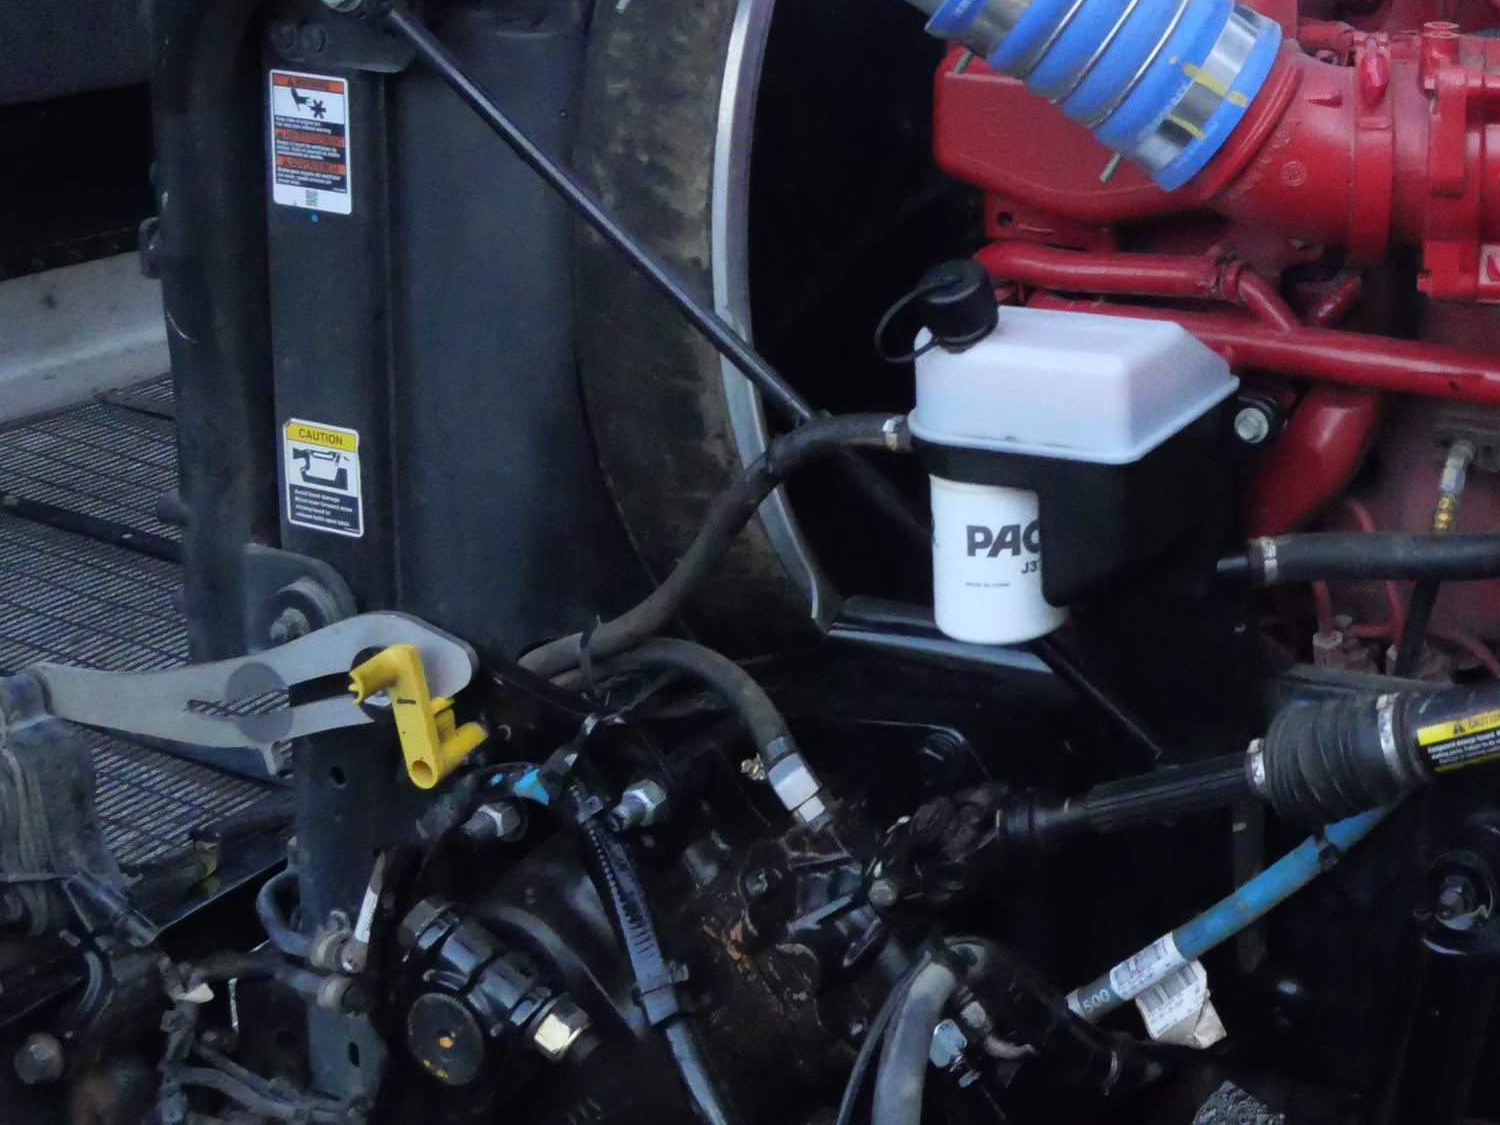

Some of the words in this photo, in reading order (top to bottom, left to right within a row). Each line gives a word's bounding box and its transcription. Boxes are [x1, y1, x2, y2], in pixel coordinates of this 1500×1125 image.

[299, 428, 343, 445] CAUTION
[1021, 560, 1041, 574] J3
[1083, 989, 1111, 1014] 500
